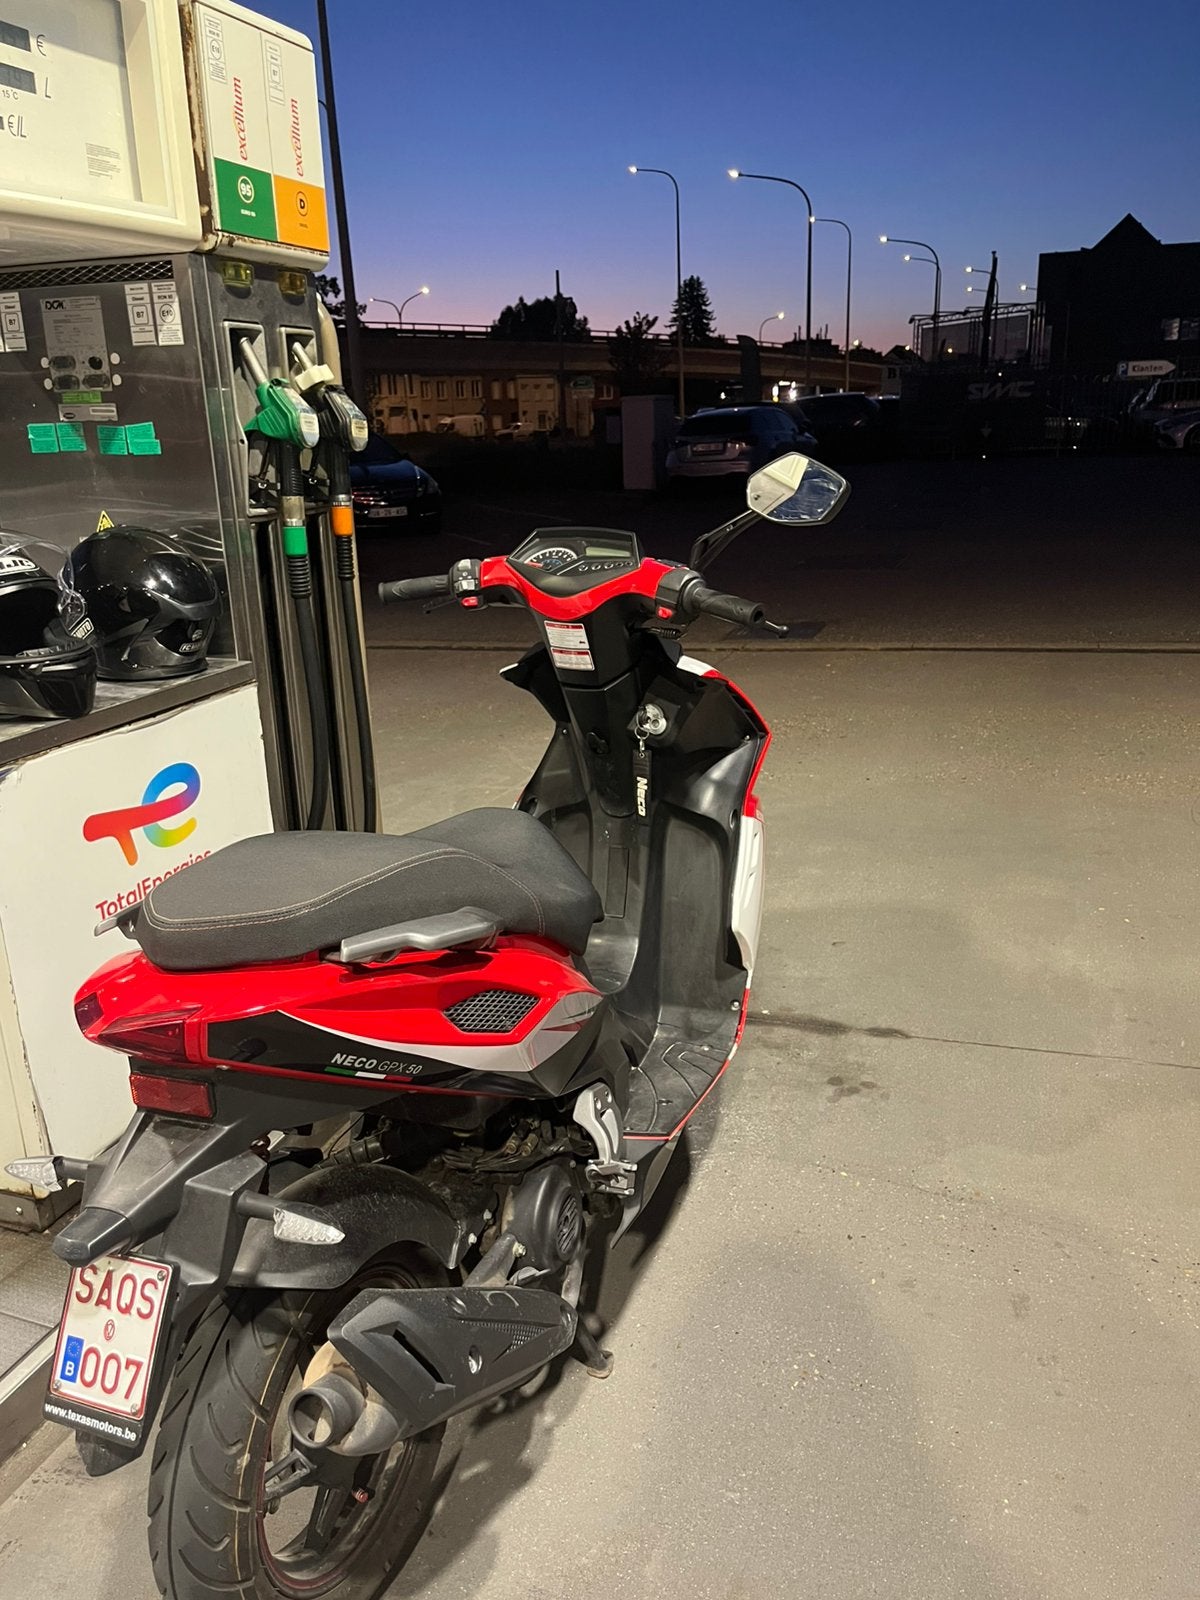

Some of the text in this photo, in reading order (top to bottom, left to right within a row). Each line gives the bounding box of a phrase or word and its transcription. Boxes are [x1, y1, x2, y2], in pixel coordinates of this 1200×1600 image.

[36, 34, 47, 57] €
[45, 77, 52, 99] L
[232, 77, 248, 161] excellum
[290, 98, 304, 177] excellum
[239, 183, 252, 197] 95
[299, 198, 306, 210] D
[330, 1053, 423, 1075] NECO GPX 50
[75, 1263, 159, 1320] SAQS
[64, 1361, 75, 1377] B
[80, 1346, 144, 1400] 007
[44, 1402, 137, 1442] www.texasmotors.be
